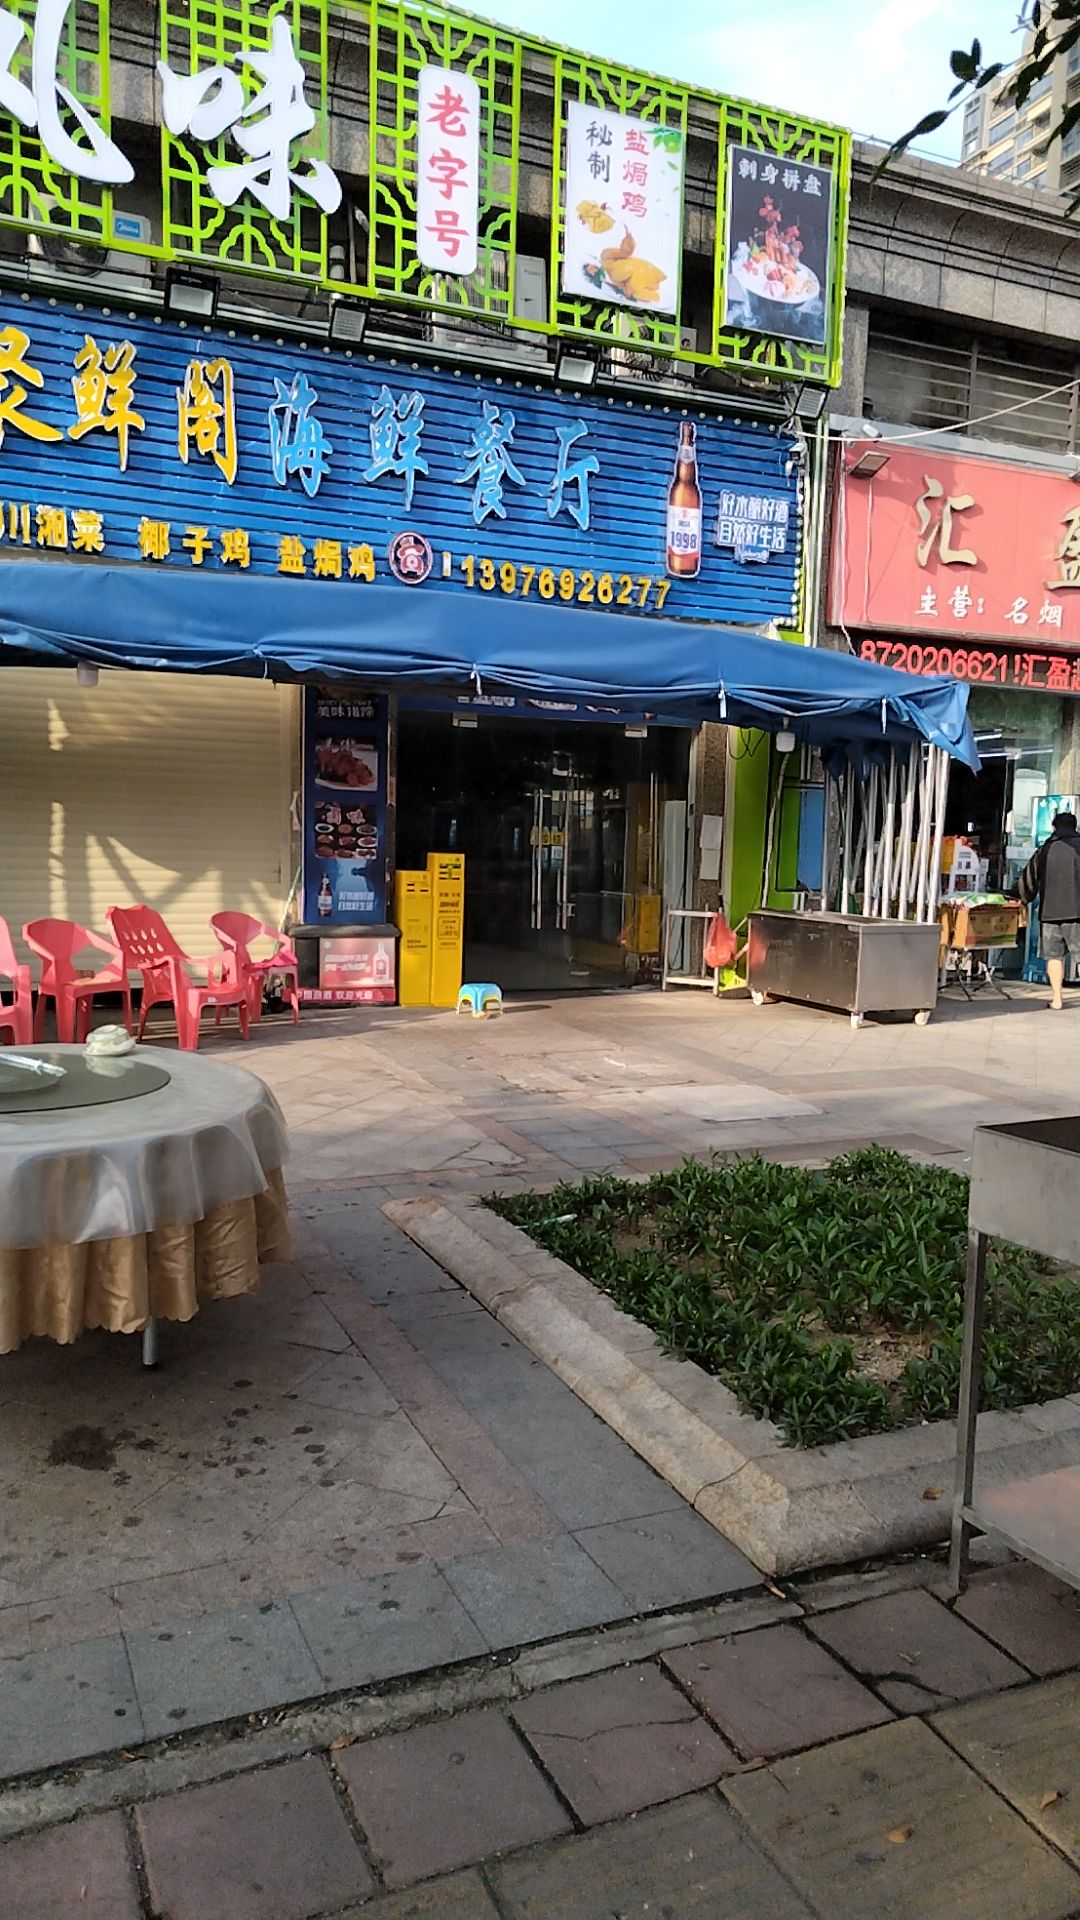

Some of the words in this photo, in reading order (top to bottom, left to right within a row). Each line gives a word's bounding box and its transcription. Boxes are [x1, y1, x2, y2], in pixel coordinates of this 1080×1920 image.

[425, 84, 471, 259] 老字号
[585, 120, 613, 184] 秘制
[620, 128, 652, 218] 盐焗鸡
[138, 516, 251, 568] 椰子鸡
[277, 534, 376, 582] 盐焗鸡
[460, 555, 672, 610] 13976926277
[670, 531, 697, 549] 1998
